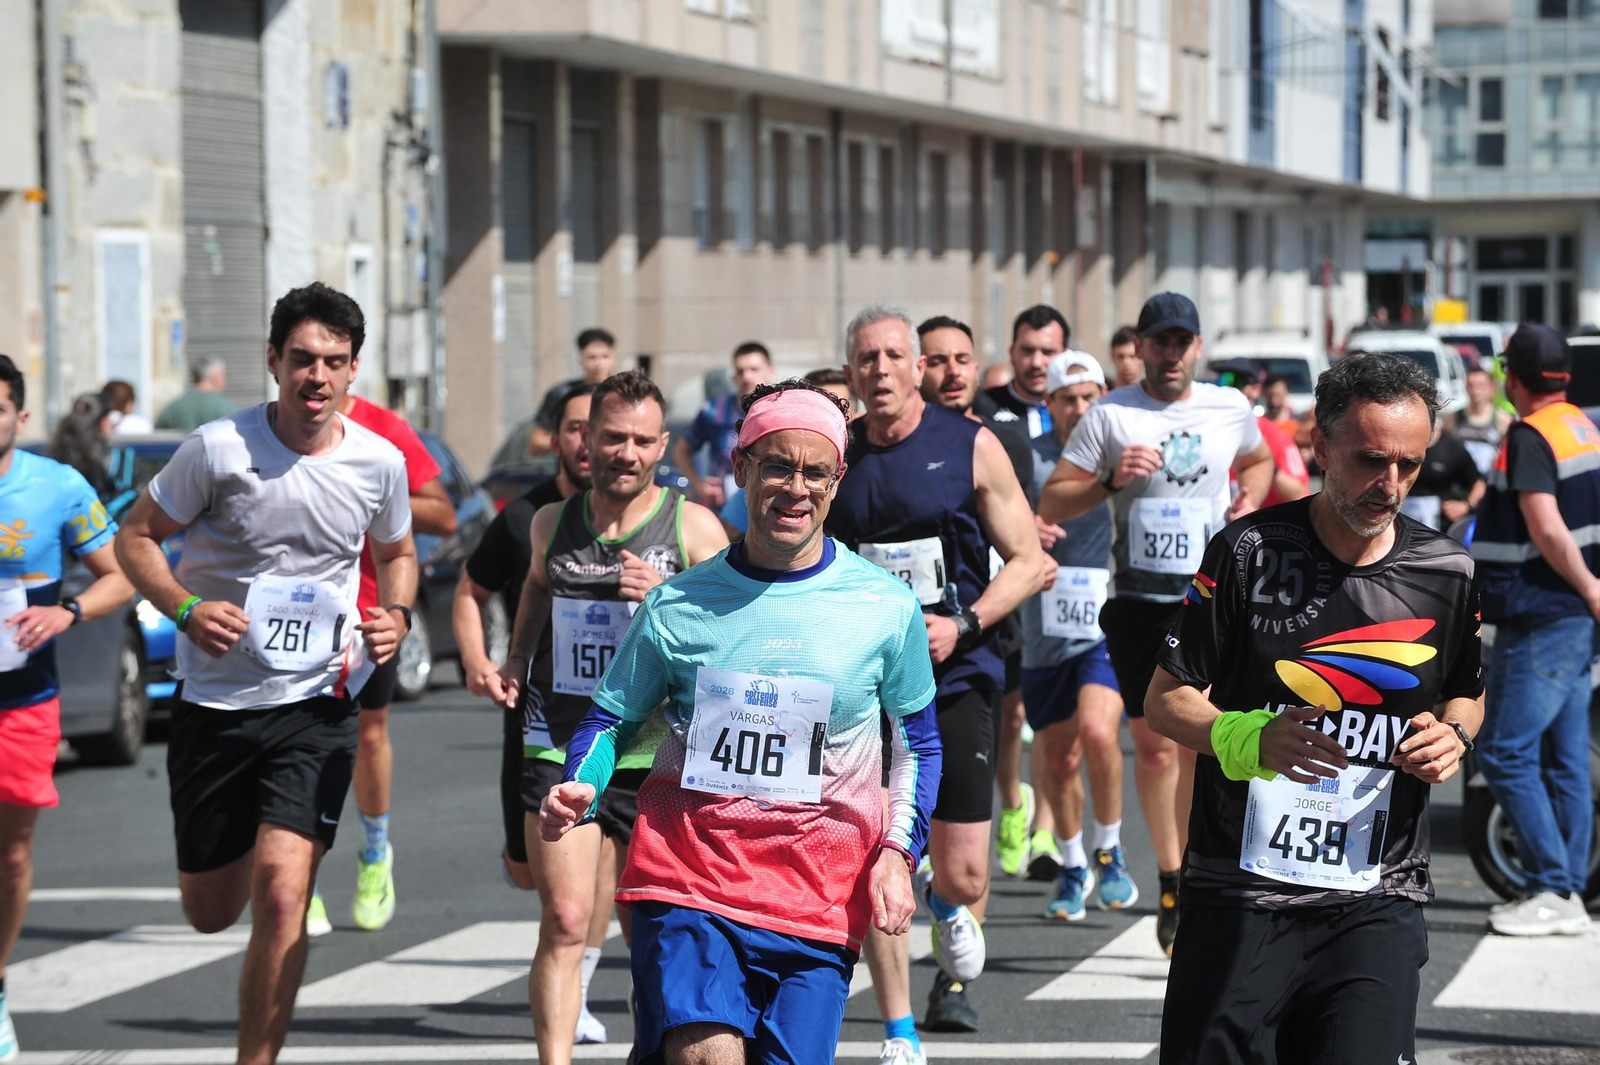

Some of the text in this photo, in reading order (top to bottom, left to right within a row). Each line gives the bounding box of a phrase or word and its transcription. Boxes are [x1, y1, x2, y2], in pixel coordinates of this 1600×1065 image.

[1260, 526, 1286, 537] GRAN
[1144, 532, 1188, 559] 326
[1251, 548, 1304, 606] 25
[266, 605, 288, 614] IAGO
[1250, 561, 1331, 635] NIVERSARIO
[1057, 599, 1095, 625] 346
[264, 618, 312, 653] 261
[710, 684, 735, 696] 2026
[729, 710, 775, 726] VARGAS
[710, 727, 786, 777] 406
[705, 782, 729, 791] OURENSE
[1294, 797, 1333, 813] JORGE
[1268, 814, 1348, 866] 439
